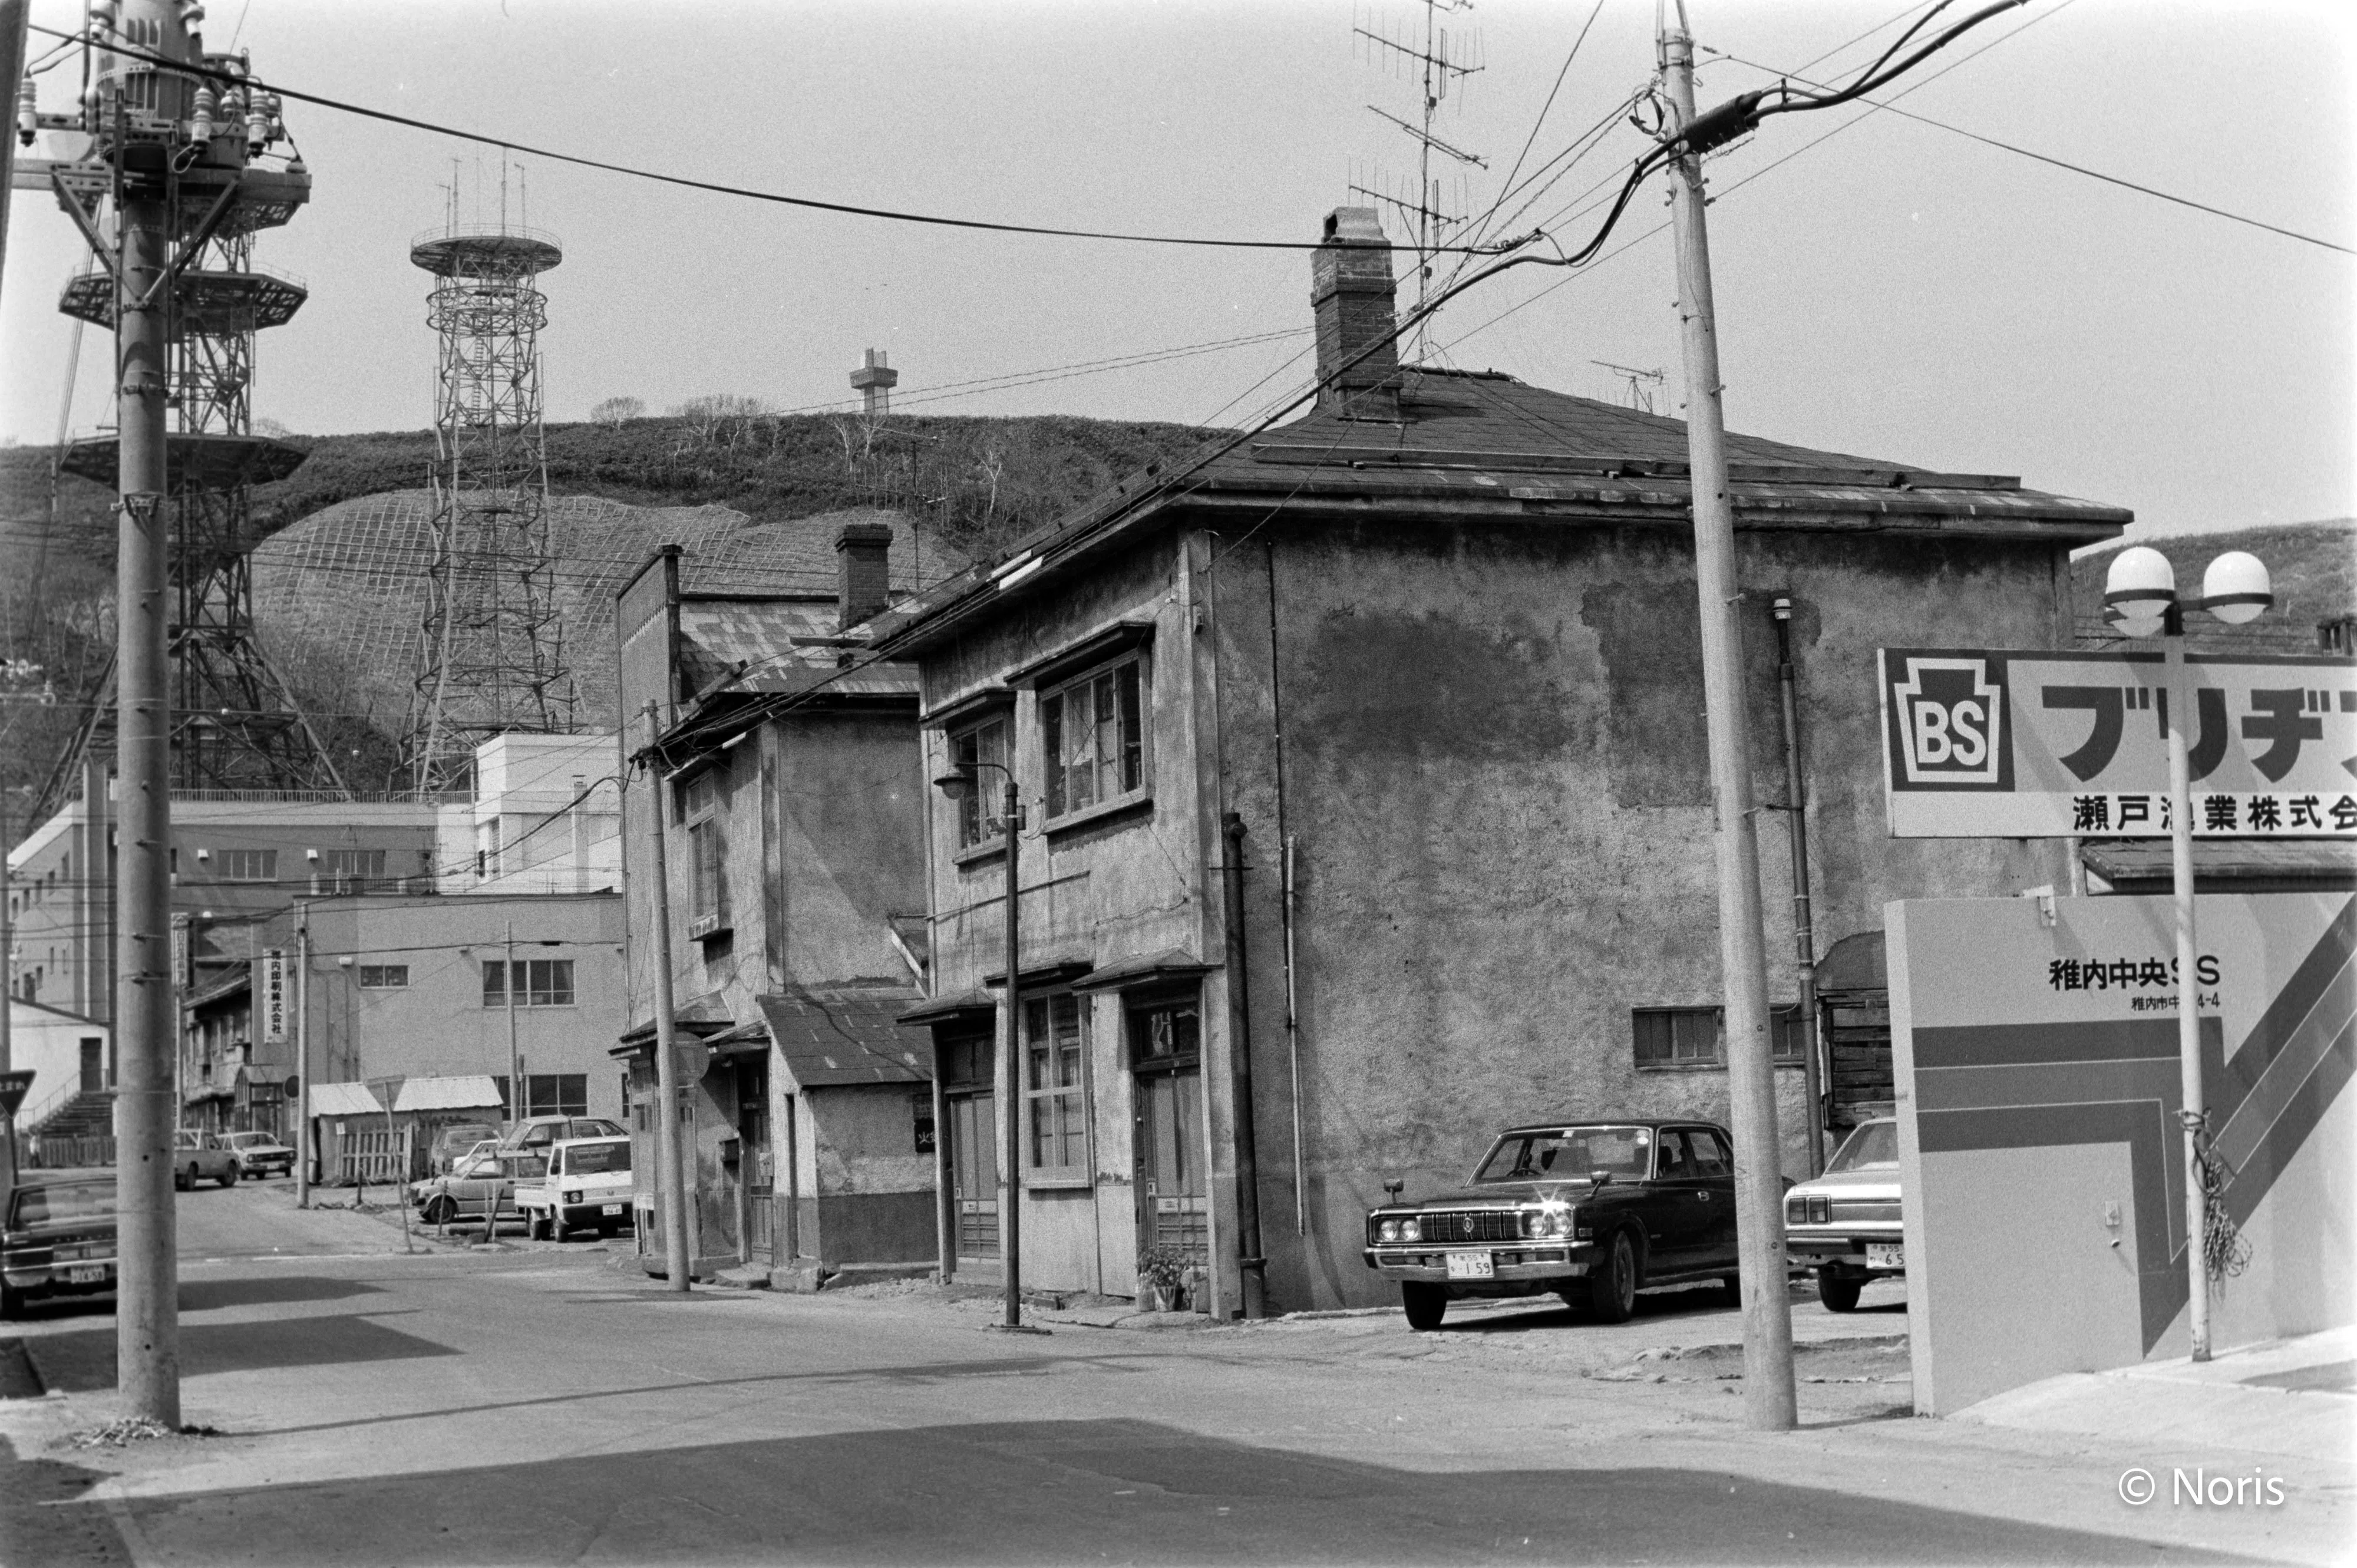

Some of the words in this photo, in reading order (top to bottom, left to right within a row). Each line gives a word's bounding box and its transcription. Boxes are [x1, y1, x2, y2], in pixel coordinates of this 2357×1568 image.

[1914, 700, 1986, 766] BS
[2041, 685, 2357, 784] ブリヂ
